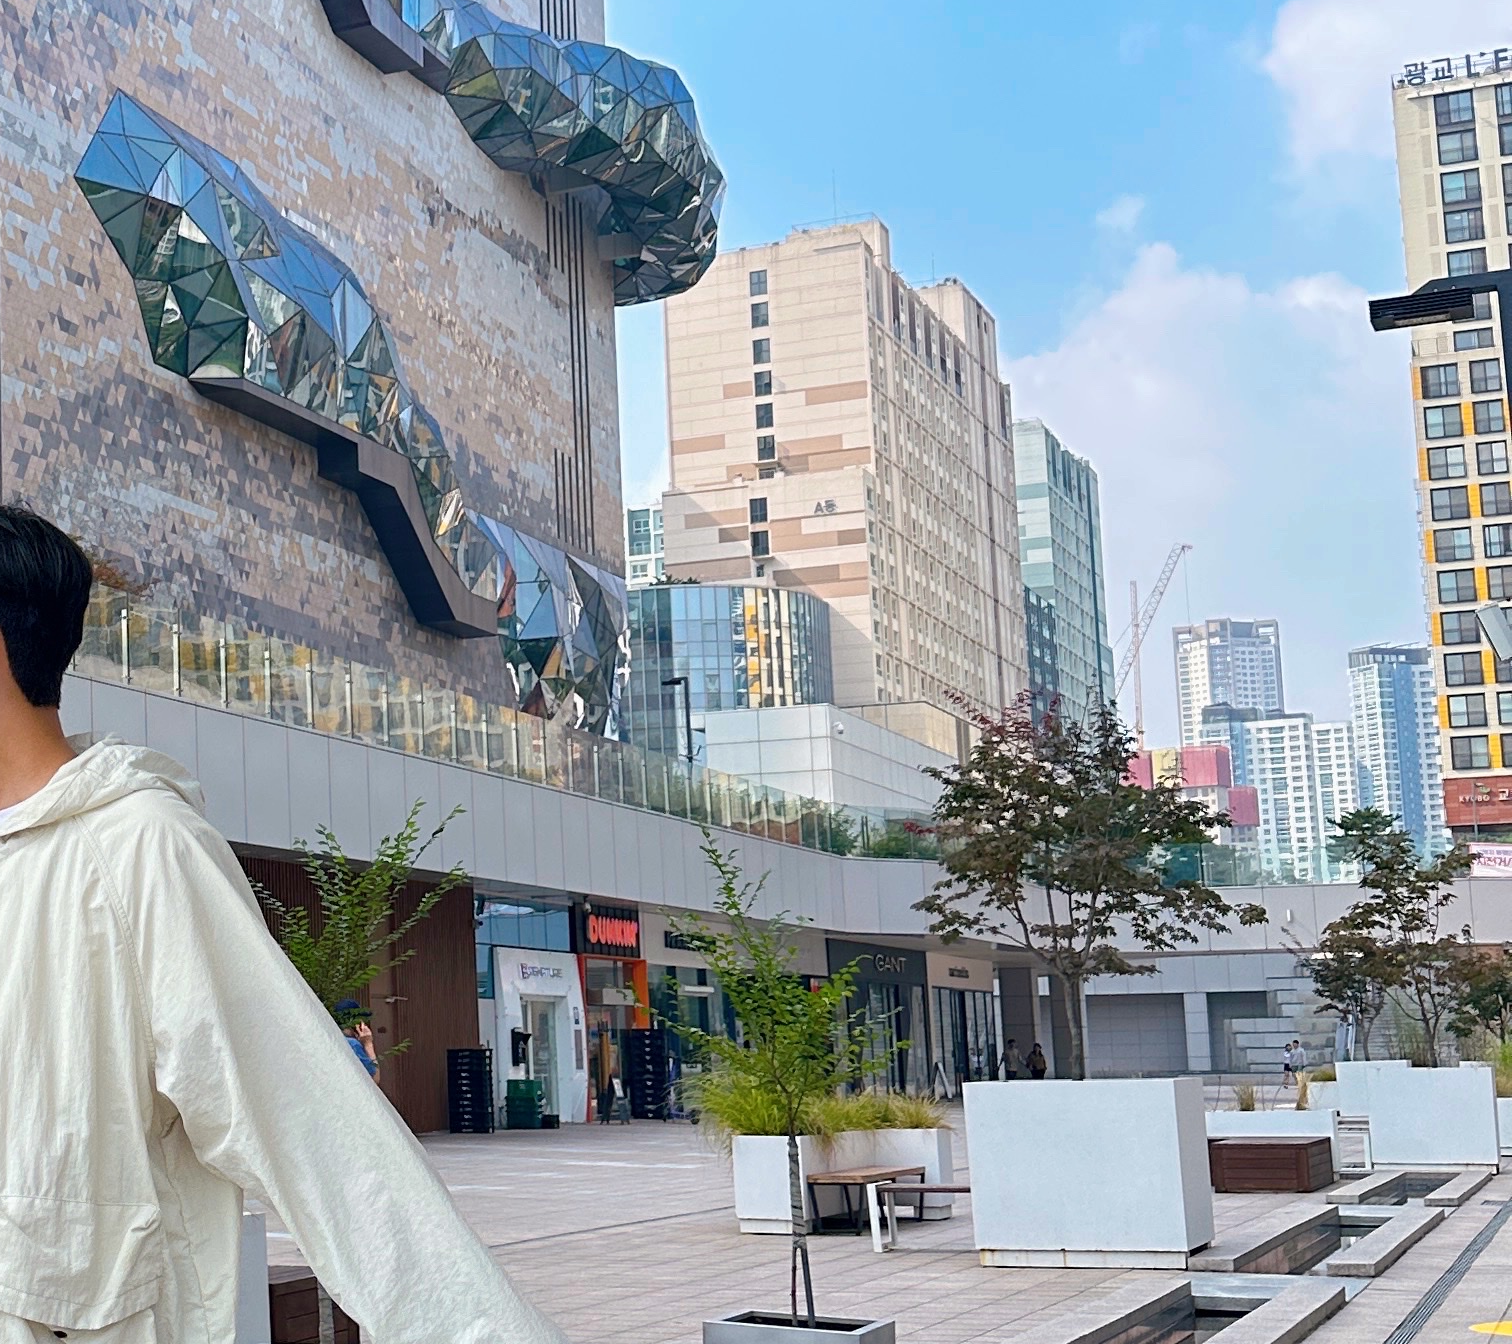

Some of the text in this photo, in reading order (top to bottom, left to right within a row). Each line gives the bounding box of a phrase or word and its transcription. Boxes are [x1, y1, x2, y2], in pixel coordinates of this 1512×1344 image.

[1404, 58, 1454, 86] 광교
[1458, 794, 1490, 803] KYOBO
[875, 953, 907, 974] GANT
